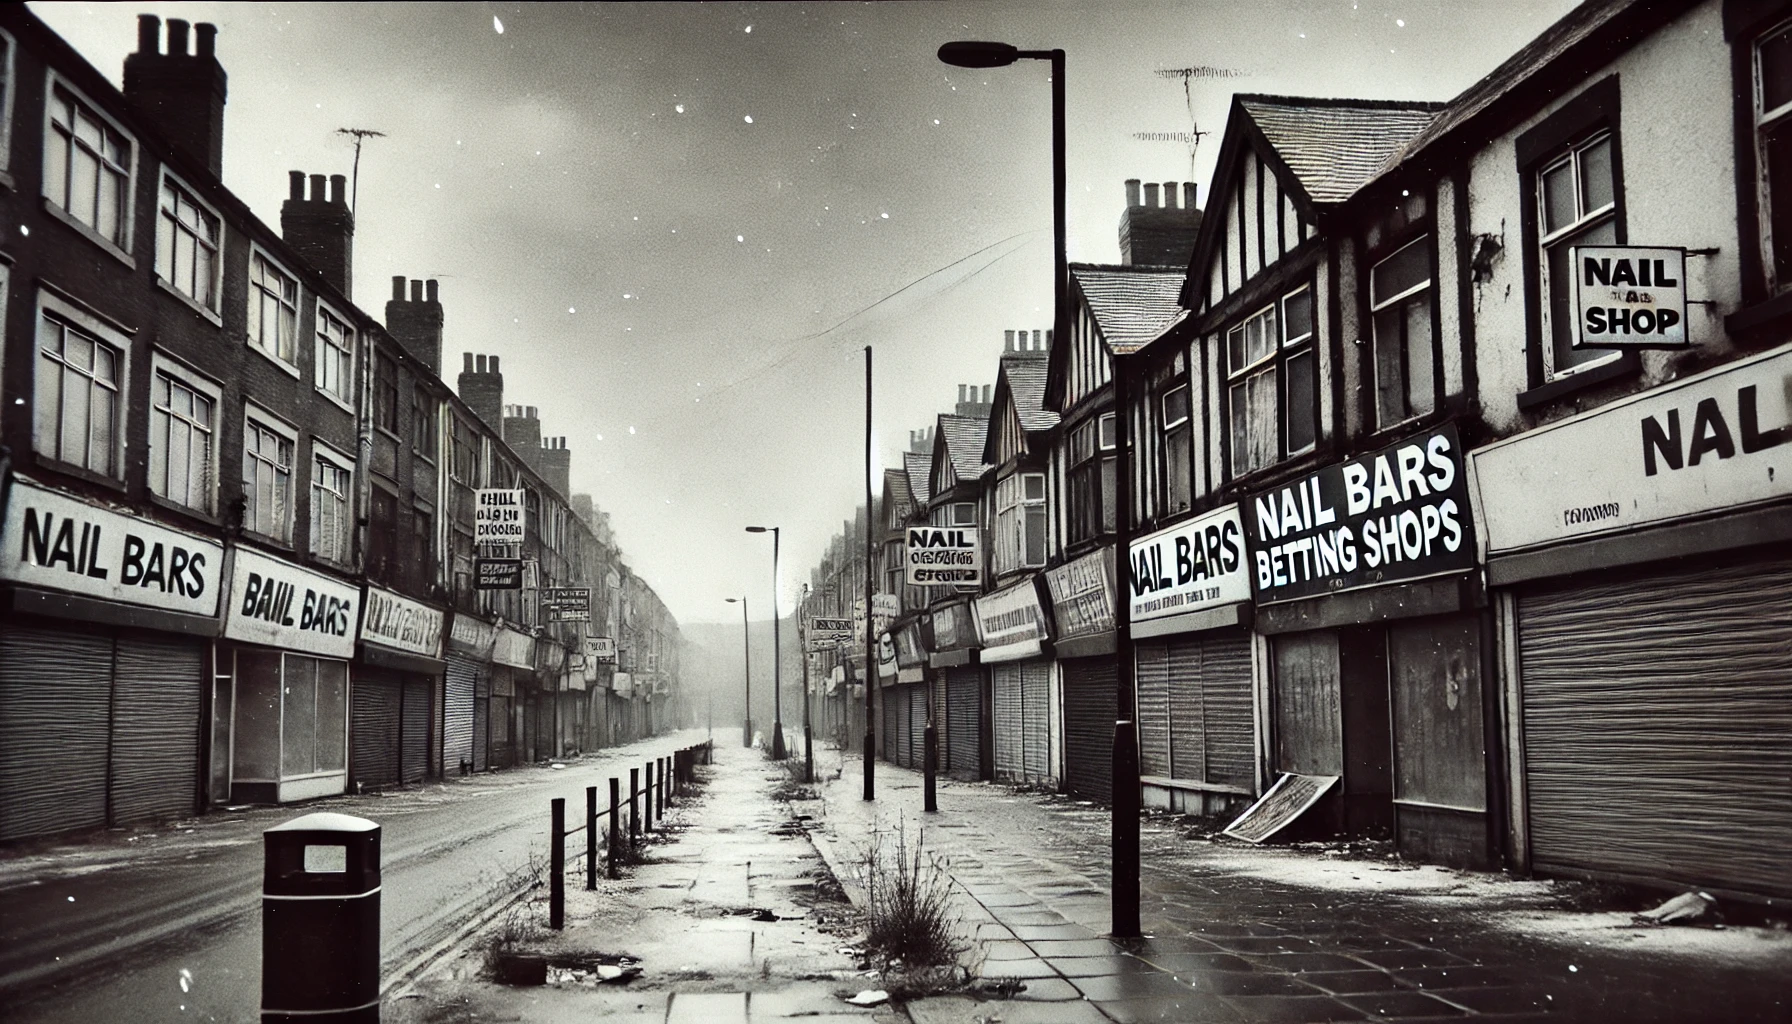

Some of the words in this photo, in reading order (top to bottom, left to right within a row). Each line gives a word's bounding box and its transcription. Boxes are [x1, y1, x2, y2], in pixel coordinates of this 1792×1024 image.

[1584, 256, 1677, 288] NAIL
[1586, 306, 1680, 335] SHOP
[1255, 476, 1336, 541] NAIL
[1342, 434, 1455, 516] BARS
[21, 507, 108, 580] NAIL
[121, 534, 206, 599] BARS
[908, 529, 975, 548] NAIL
[1175, 519, 1239, 586] BARS
[1255, 526, 1357, 590] BETTING
[1364, 498, 1462, 568] SHOPS
[299, 588, 351, 637] BARS
